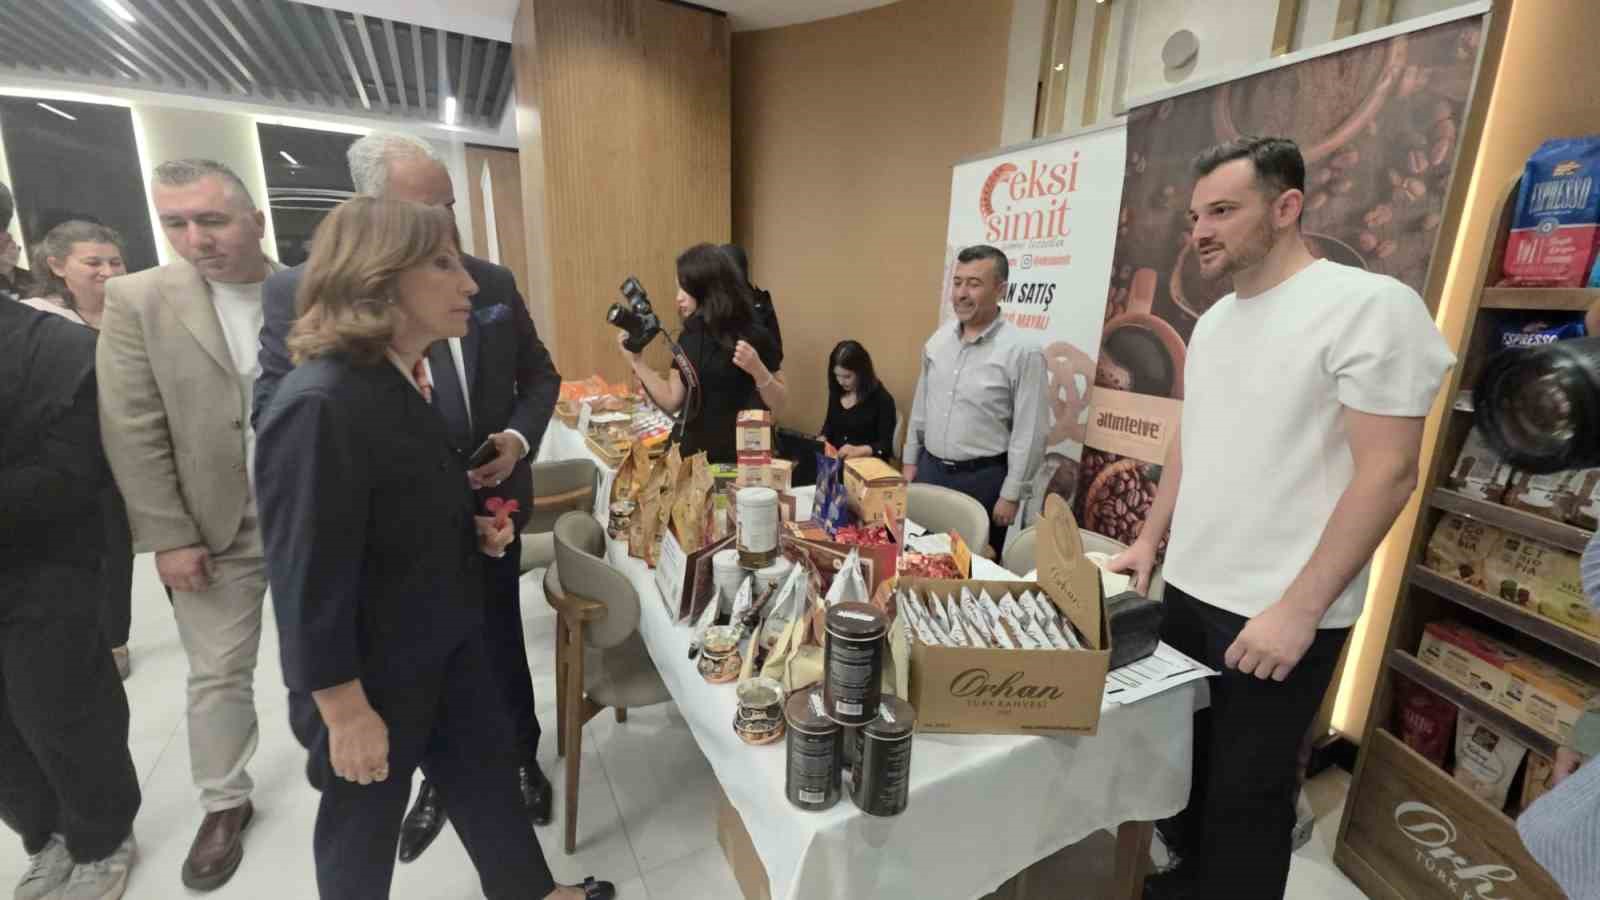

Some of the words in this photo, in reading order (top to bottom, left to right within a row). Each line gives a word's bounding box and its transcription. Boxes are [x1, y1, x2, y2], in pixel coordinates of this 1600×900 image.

[1529, 176, 1591, 214] ESPRESSO
[985, 199, 1072, 242] simit
[1017, 283, 1057, 312] SATIŞ
[949, 668, 1065, 701] Orhan
